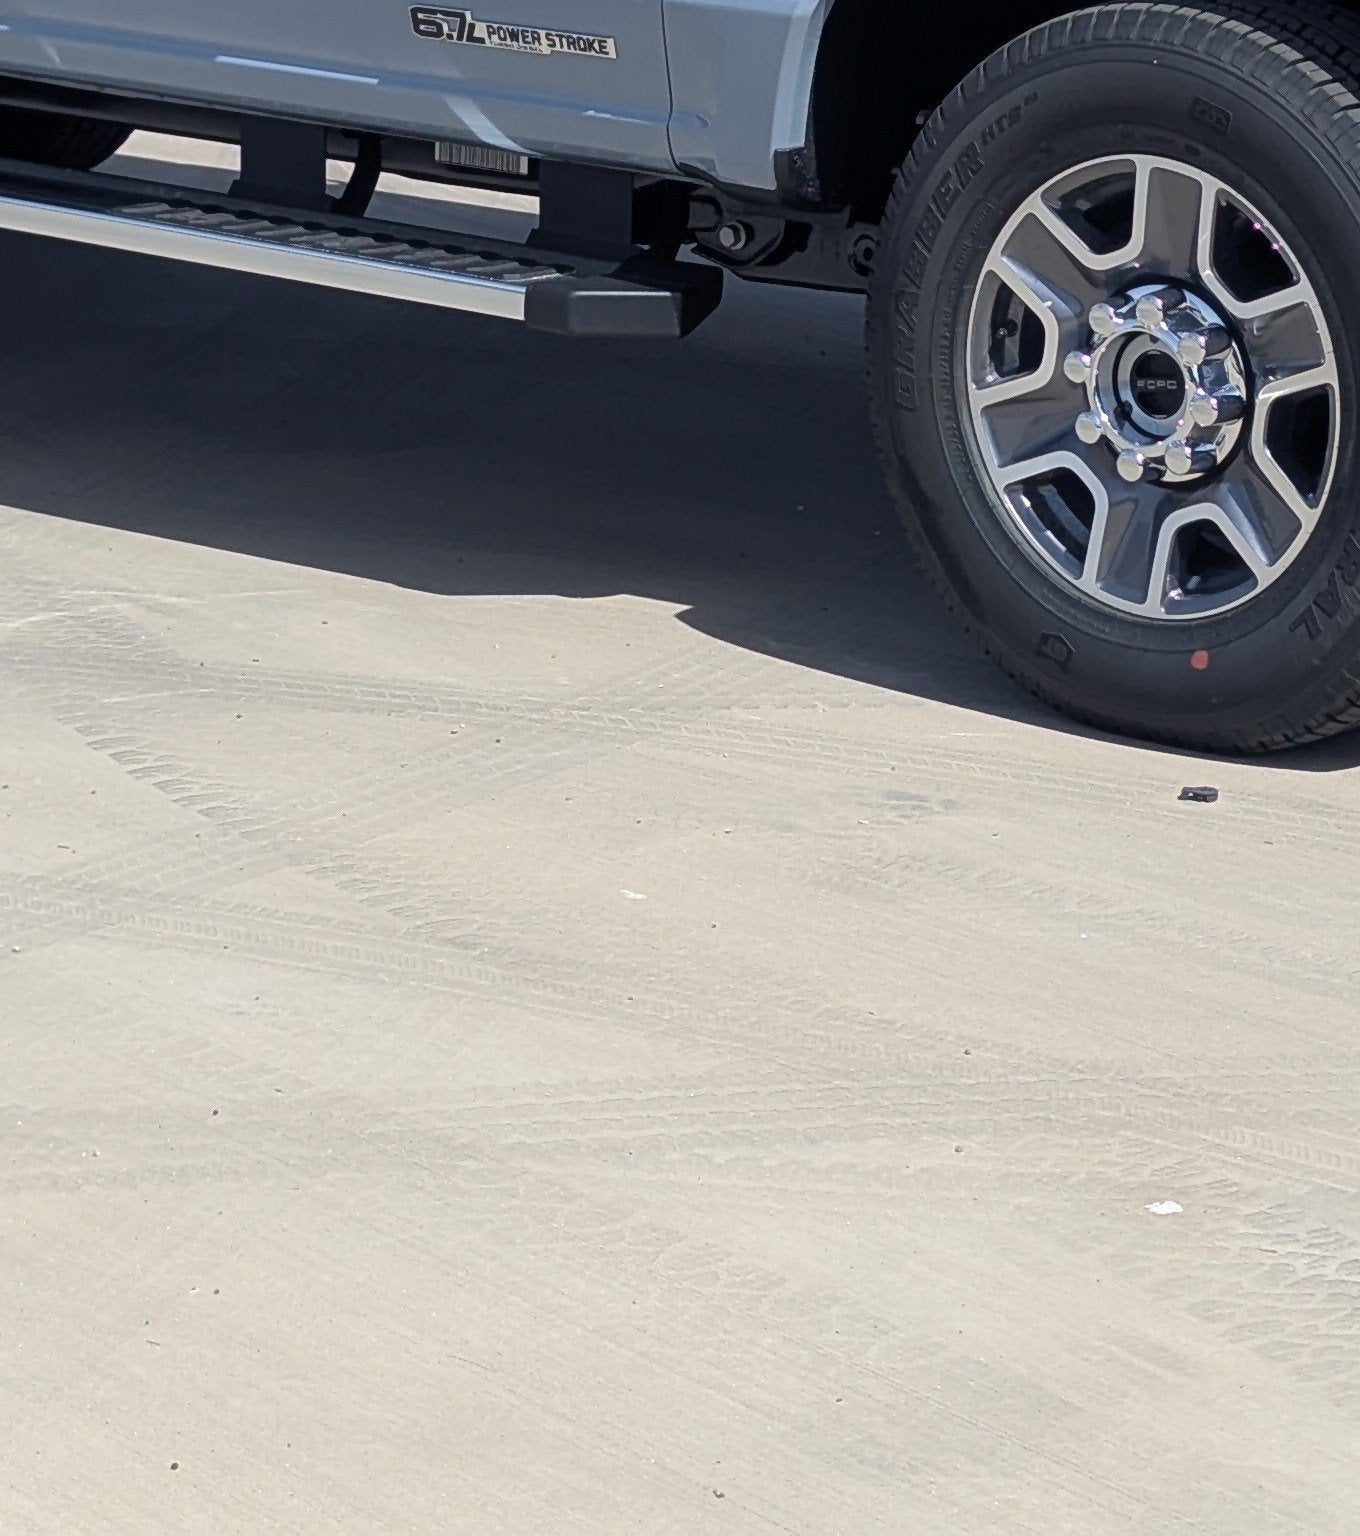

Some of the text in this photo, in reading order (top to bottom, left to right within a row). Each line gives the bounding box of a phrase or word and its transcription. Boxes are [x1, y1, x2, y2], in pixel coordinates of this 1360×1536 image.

[409, 5, 486, 45] 6.7L
[485, 24, 543, 46] POWER
[544, 31, 611, 56] STROKE
[894, 141, 986, 411] GRABBER
